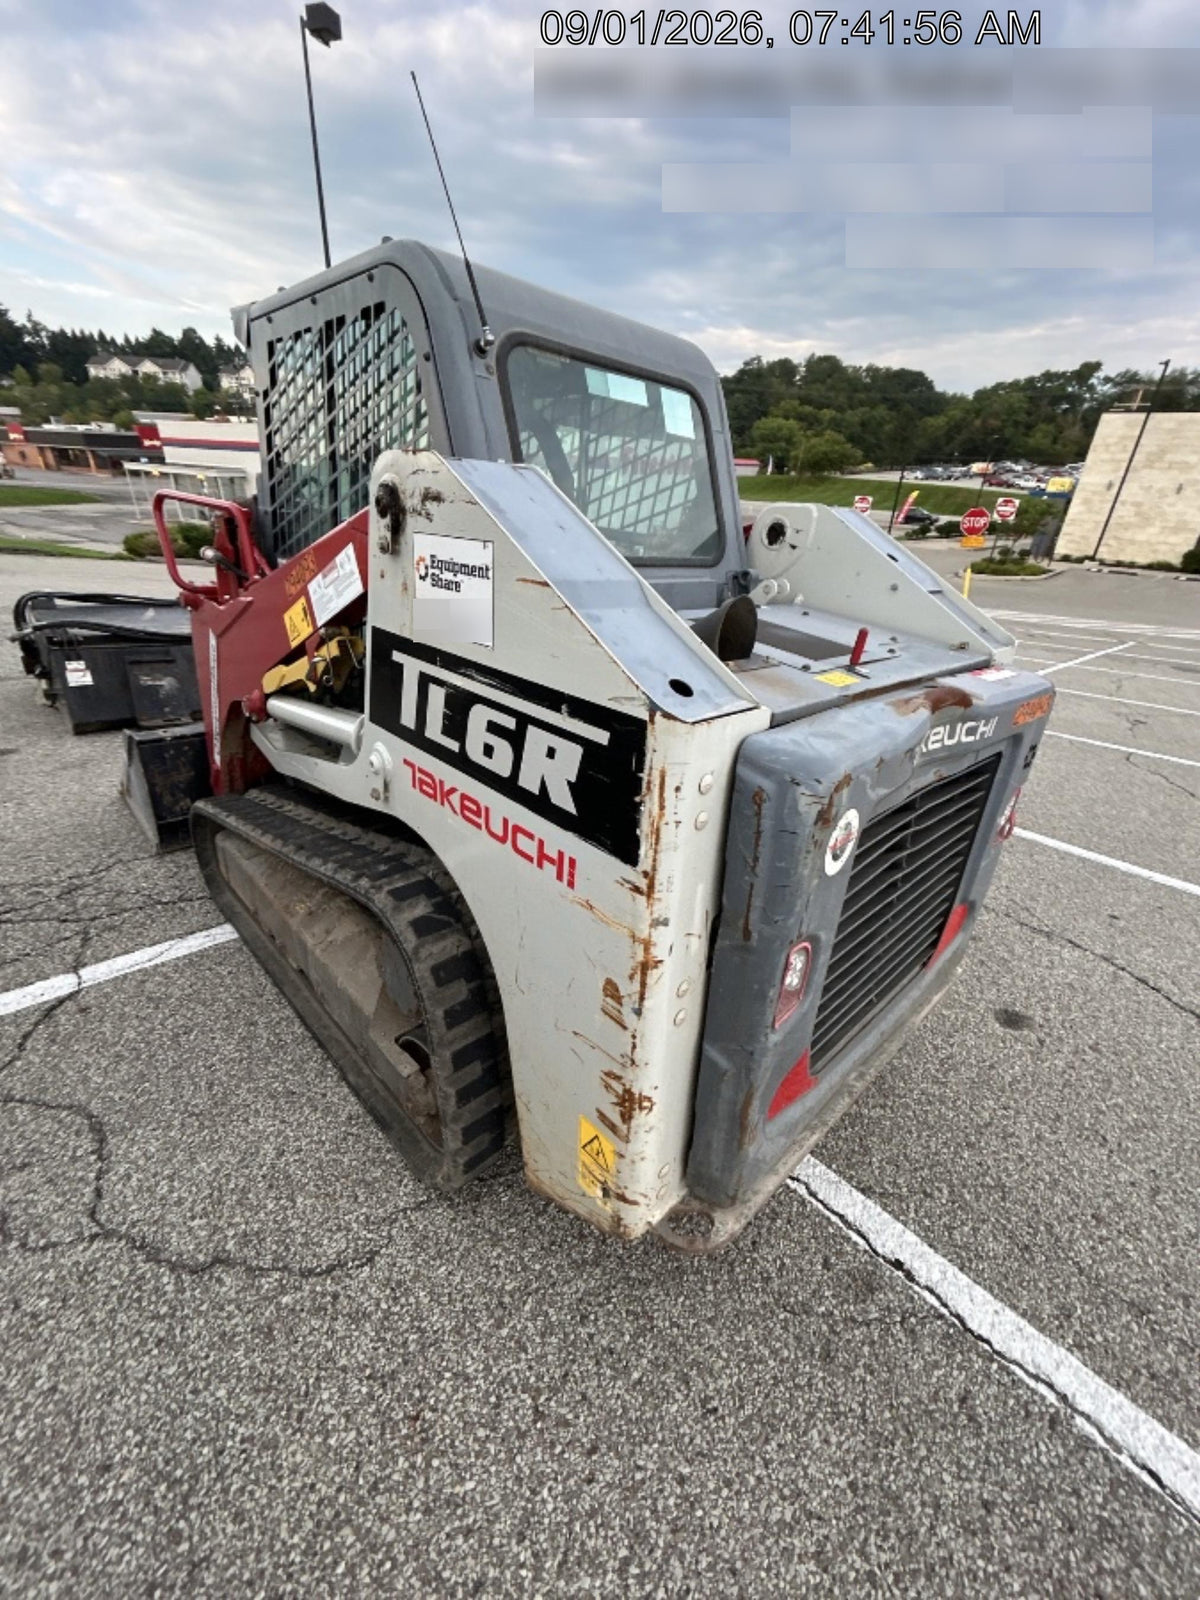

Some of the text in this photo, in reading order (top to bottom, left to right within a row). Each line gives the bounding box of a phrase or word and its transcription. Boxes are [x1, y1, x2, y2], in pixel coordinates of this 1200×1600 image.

[963, 517, 988, 529] STOP
[429, 554, 491, 580] Equipment
[430, 572, 462, 593] Share
[391, 650, 611, 816] TL6R
